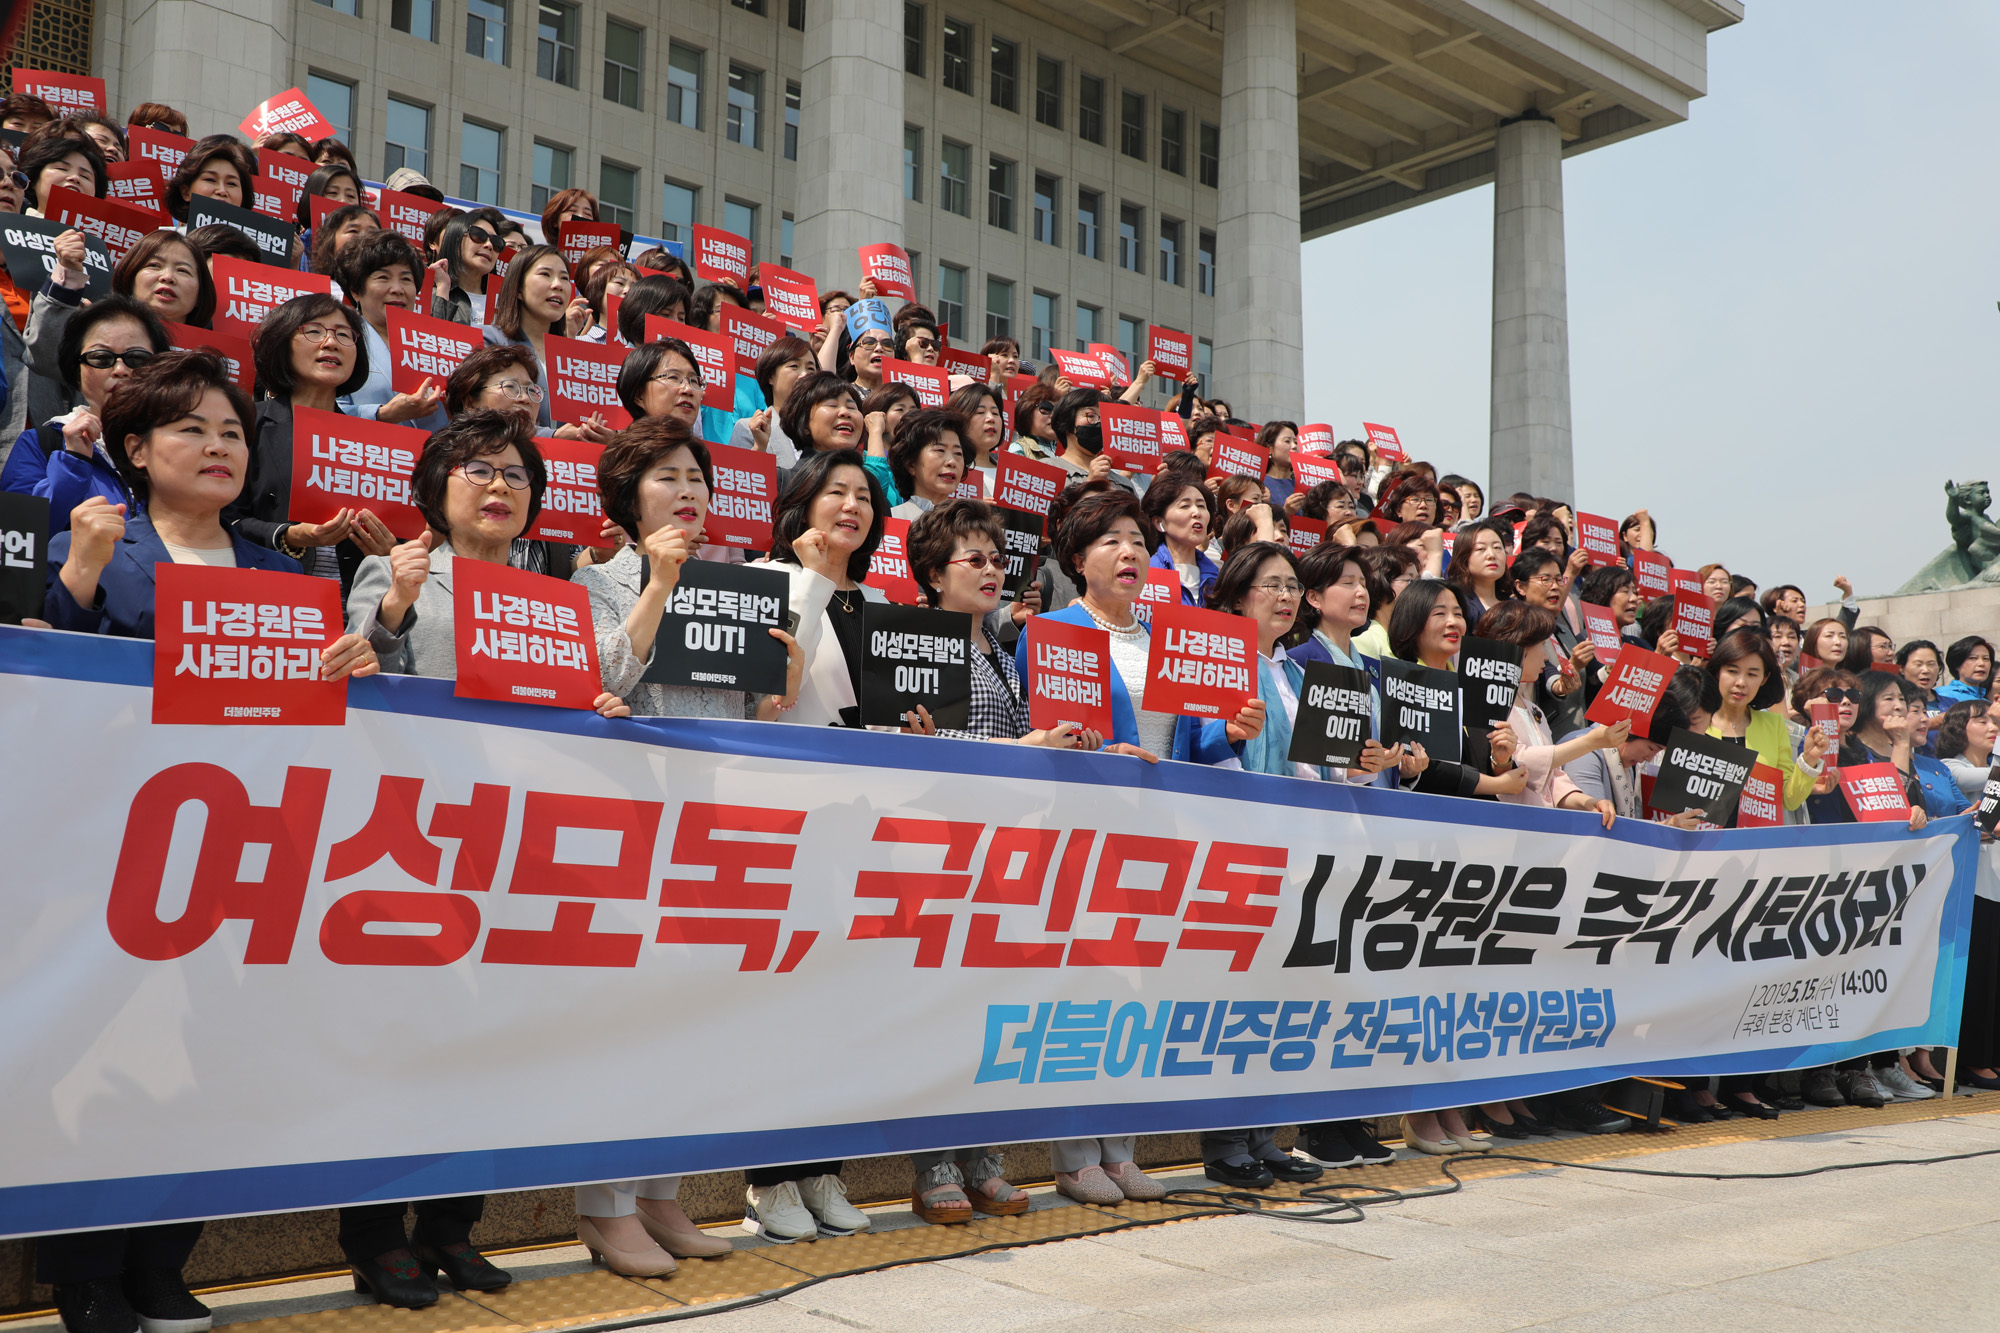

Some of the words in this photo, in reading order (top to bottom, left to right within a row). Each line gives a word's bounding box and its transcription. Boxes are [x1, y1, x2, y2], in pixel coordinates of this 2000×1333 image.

[269, 165, 309, 188] 나경원
[391, 204, 431, 226] 나경원
[701, 238, 747, 263] 나경원은
[701, 253, 747, 279] 사퇴하라!
[869, 254, 909, 274] 나경원은
[871, 268, 912, 288] 사퇴하라!
[228, 277, 315, 306] 나경원
[768, 285, 812, 306] 나경원은
[770, 298, 816, 320] 사퇴하라!
[400, 327, 473, 360] 나경원은
[729, 319, 777, 346] 나경원은
[1154, 337, 1187, 355] 나경원은
[557, 355, 621, 385] 나경원은
[944, 359, 986, 380] 나경원은
[1153, 350, 1188, 369] 사퇴하라!
[890, 370, 941, 393] 나경원은
[1109, 417, 1157, 439] 나경원은
[1161, 433, 1186, 446] 하라!
[312, 434, 415, 476] 나경원은
[1109, 435, 1160, 457] 사퇴하라!
[1219, 444, 1262, 470] 나경원은
[1004, 467, 1057, 498] 나경원은
[1297, 462, 1336, 480] 나경원은
[540, 527, 574, 540] 더불어민주당
[1583, 524, 1615, 542] 나경원은
[1583, 538, 1617, 556] 사퇴하라!
[1639, 561, 1668, 579] 나경원은
[1639, 575, 1669, 593] 사퇴하라!
[182, 600, 325, 641] 나경원은
[473, 590, 580, 638] 나경원은
[1679, 602, 1711, 624] 나경원은
[684, 622, 746, 655] OUT!
[1675, 619, 1712, 640] 사퇴하라!
[471, 628, 590, 672] 사퇴하라!
[871, 630, 965, 665] 여성모독발언
[1165, 628, 1246, 664] 나경원은
[1036, 642, 1099, 678] 나경원은
[691, 671, 737, 685] 더불어민주당
[894, 665, 939, 695] OUT!
[1157, 657, 1250, 693] 사퇴하라!
[1618, 664, 1664, 693] 나경원은
[511, 684, 557, 700] 더불어민주당
[1036, 673, 1103, 708] 사퇴하라!
[1386, 676, 1453, 712] 여성모독발언
[1605, 685, 1656, 714] 사퇴하라!
[223, 705, 282, 719] 더불어민주당
[1183, 702, 1220, 714] 더불어민주당
[1399, 706, 1430, 733] OUT!
[1326, 715, 1361, 742] OUT!
[1670, 747, 1748, 785] 여성모독발언
[1686, 775, 1725, 802] OUT!
[1846, 776, 1899, 795] 나경원은
[1855, 794, 1907, 812] 사퇴하라!
[106, 762, 820, 974] 여성모독,
[846, 816, 1289, 973] 국민모독
[1281, 854, 1567, 974] 나경원은
[1563, 871, 1720, 965] 즉각
[1692, 863, 1927, 963] 사퇴하라!
[1841, 968, 1888, 996] 14:00
[1742, 1011, 1769, 1037] 국회
[1769, 1008, 1796, 1034] 본청
[1796, 1004, 1823, 1031] 계단
[1825, 1003, 1840, 1029] 앞
[974, 998, 1332, 1085] 더불어민주당
[1330, 986, 1618, 1070] 전국여성위원회
